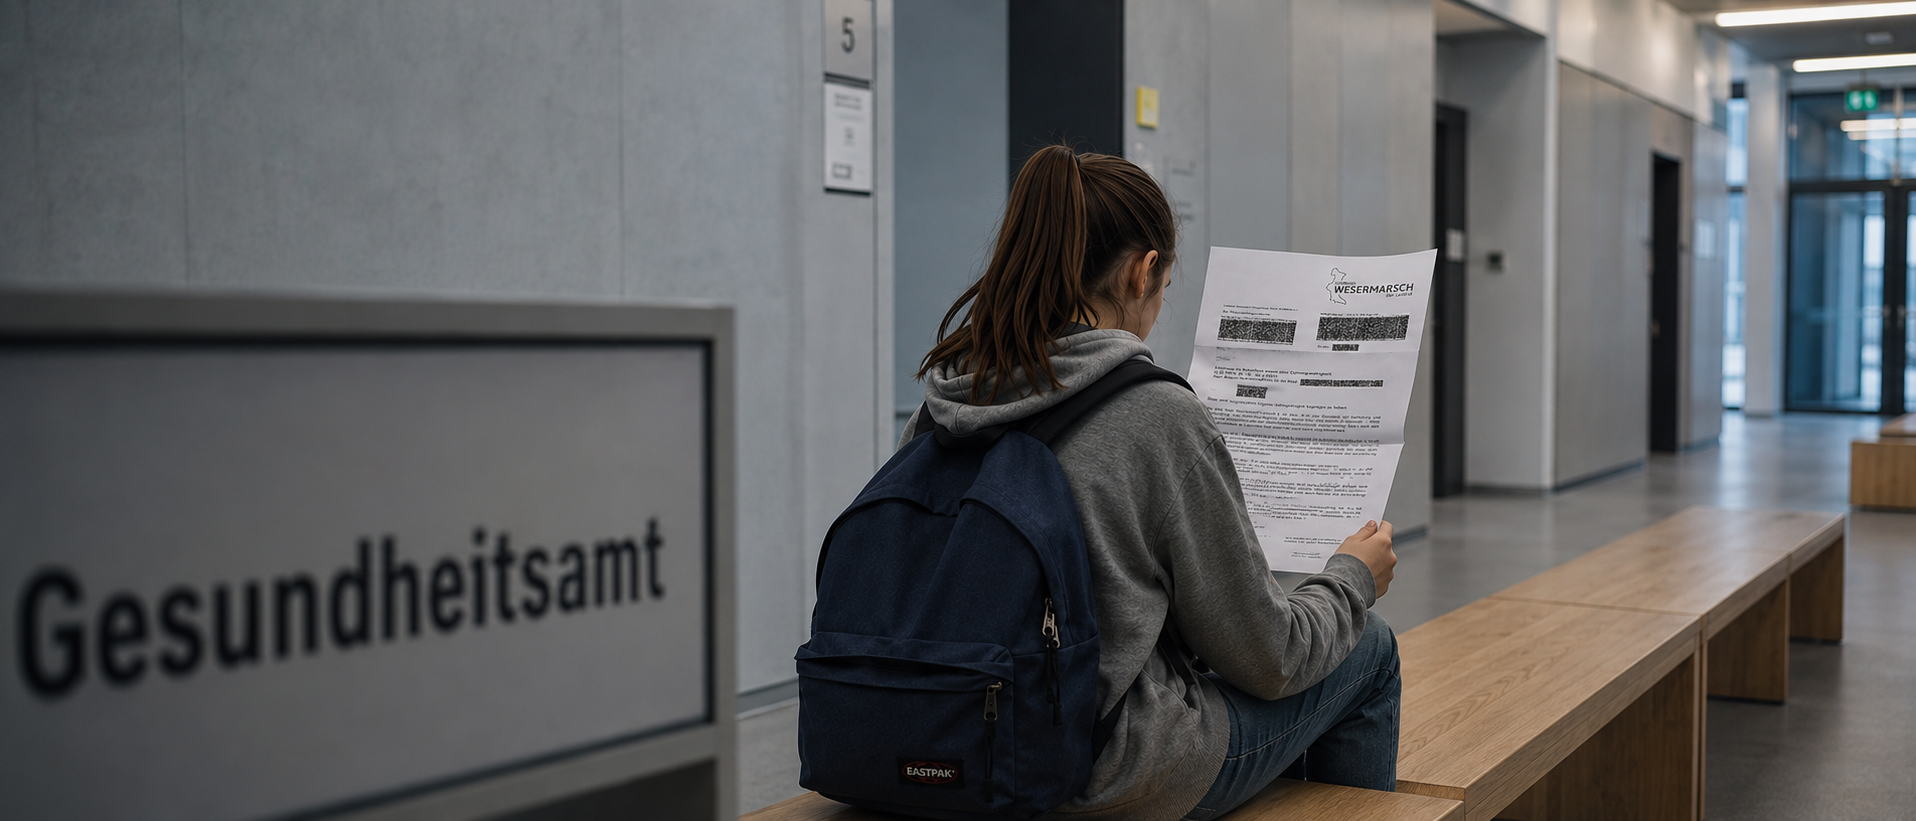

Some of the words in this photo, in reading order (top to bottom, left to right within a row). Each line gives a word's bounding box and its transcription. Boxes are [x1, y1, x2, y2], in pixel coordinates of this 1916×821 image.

[841, 17, 856, 53] 5
[1334, 283, 1414, 294] WESERMARSCH
[18, 517, 664, 700] Gesundheitsamt
[906, 766, 953, 778] EASTPAK
